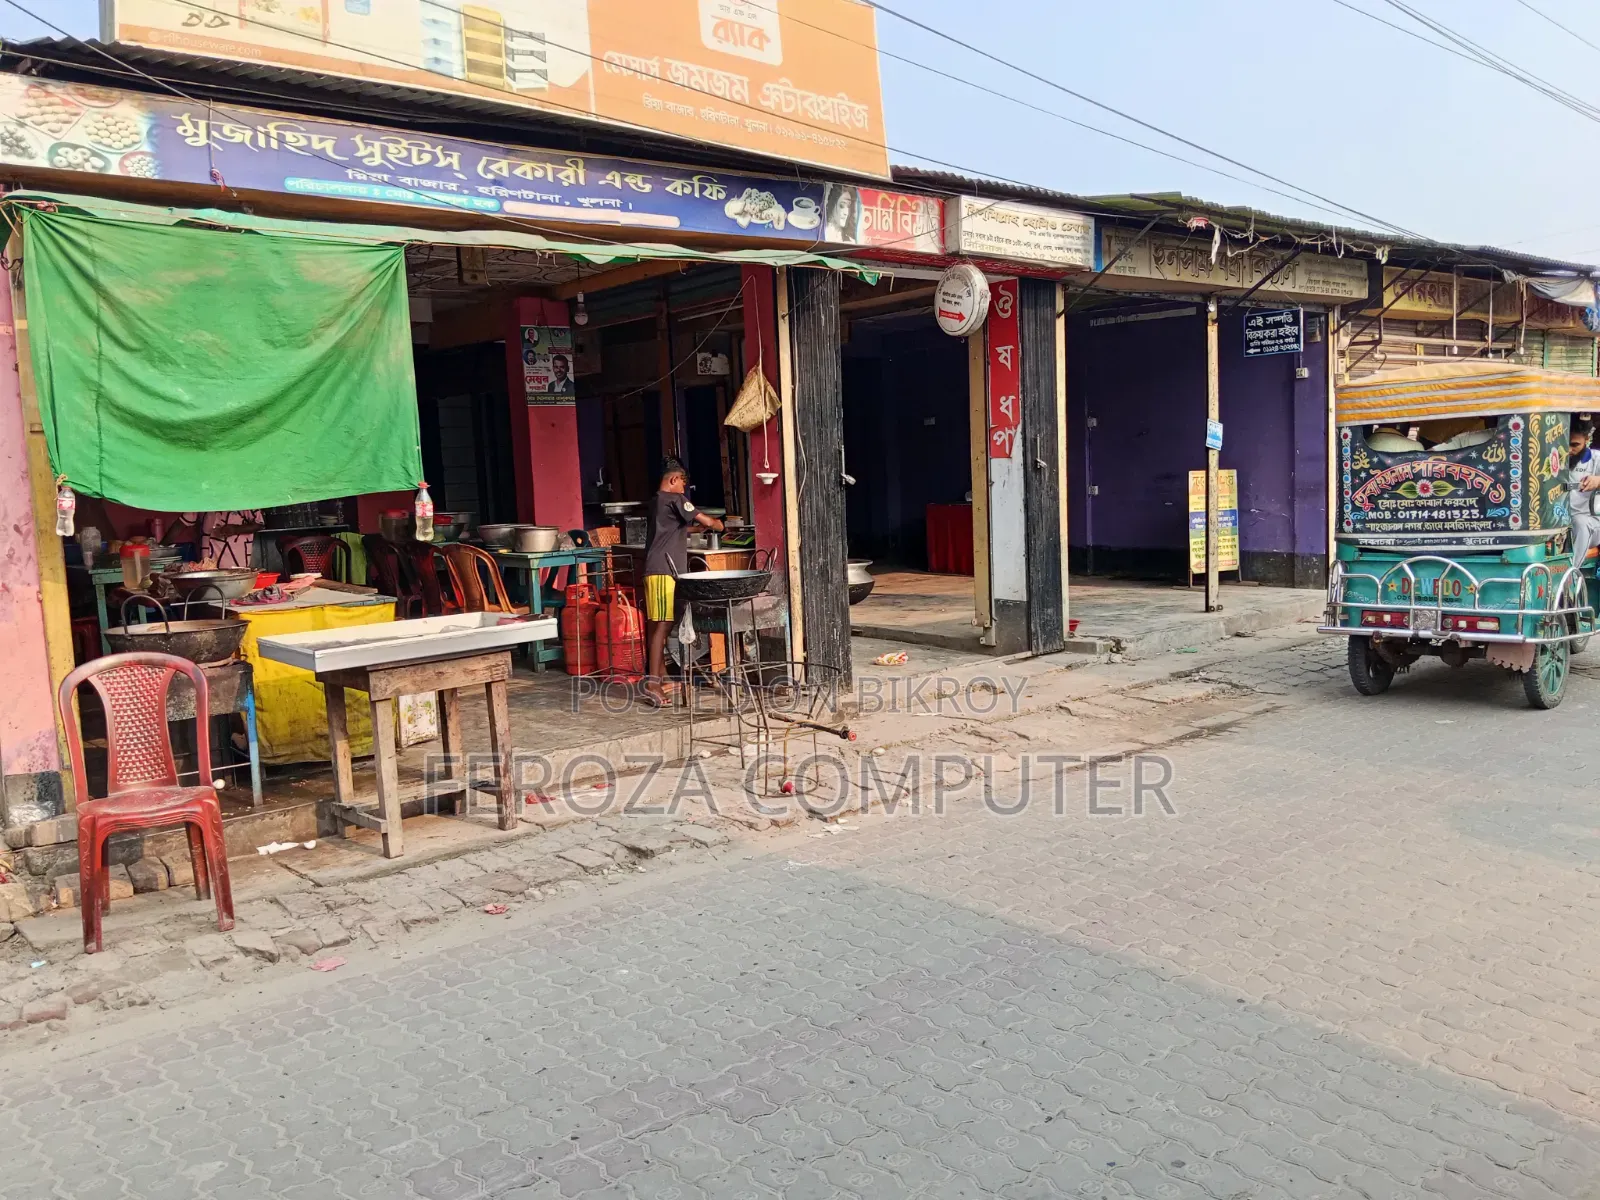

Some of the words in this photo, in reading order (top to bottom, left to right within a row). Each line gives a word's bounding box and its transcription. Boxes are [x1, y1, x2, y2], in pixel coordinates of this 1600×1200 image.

[664, 57, 750, 105] জমজম
[758, 77, 870, 131] এন্টারপ্রাইজ
[171, 113, 349, 161] মুজাহিদ
[477, 158, 587, 187] বেকারী
[599, 170, 653, 193] এন্ড
[662, 174, 728, 201] কফি
[1248, 316, 1264, 328] এই
[1265, 311, 1294, 325] সম্পত্তি
[1277, 324, 1299, 337] হইবে
